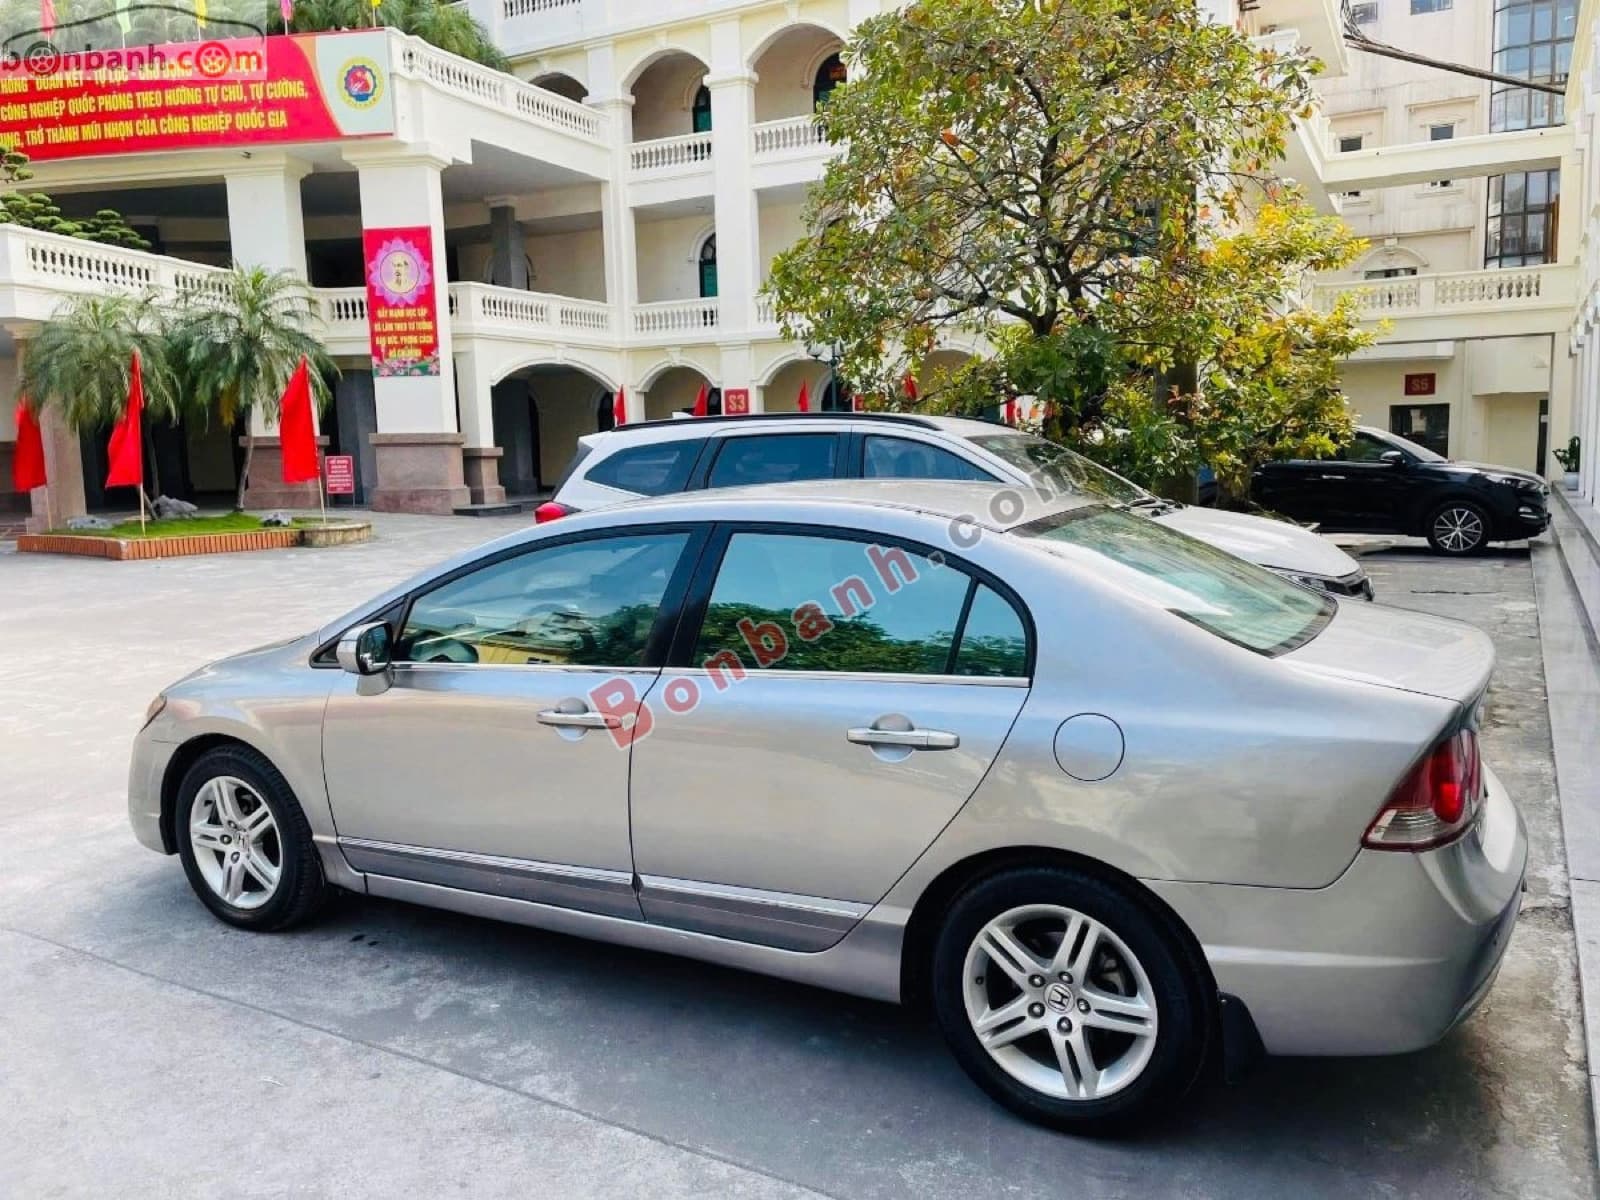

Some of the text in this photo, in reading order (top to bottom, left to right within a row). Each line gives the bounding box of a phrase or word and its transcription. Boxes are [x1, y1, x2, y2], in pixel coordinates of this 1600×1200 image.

[68, 91, 96, 116] QUỐC
[97, 90, 134, 112] PHÒNG
[136, 89, 162, 109] THEO
[45, 123, 80, 145] THÀNH
[135, 113, 158, 137] CỦA
[235, 106, 265, 131] QUỐC
[267, 109, 288, 128] GIA
[728, 394, 745, 411] S3
